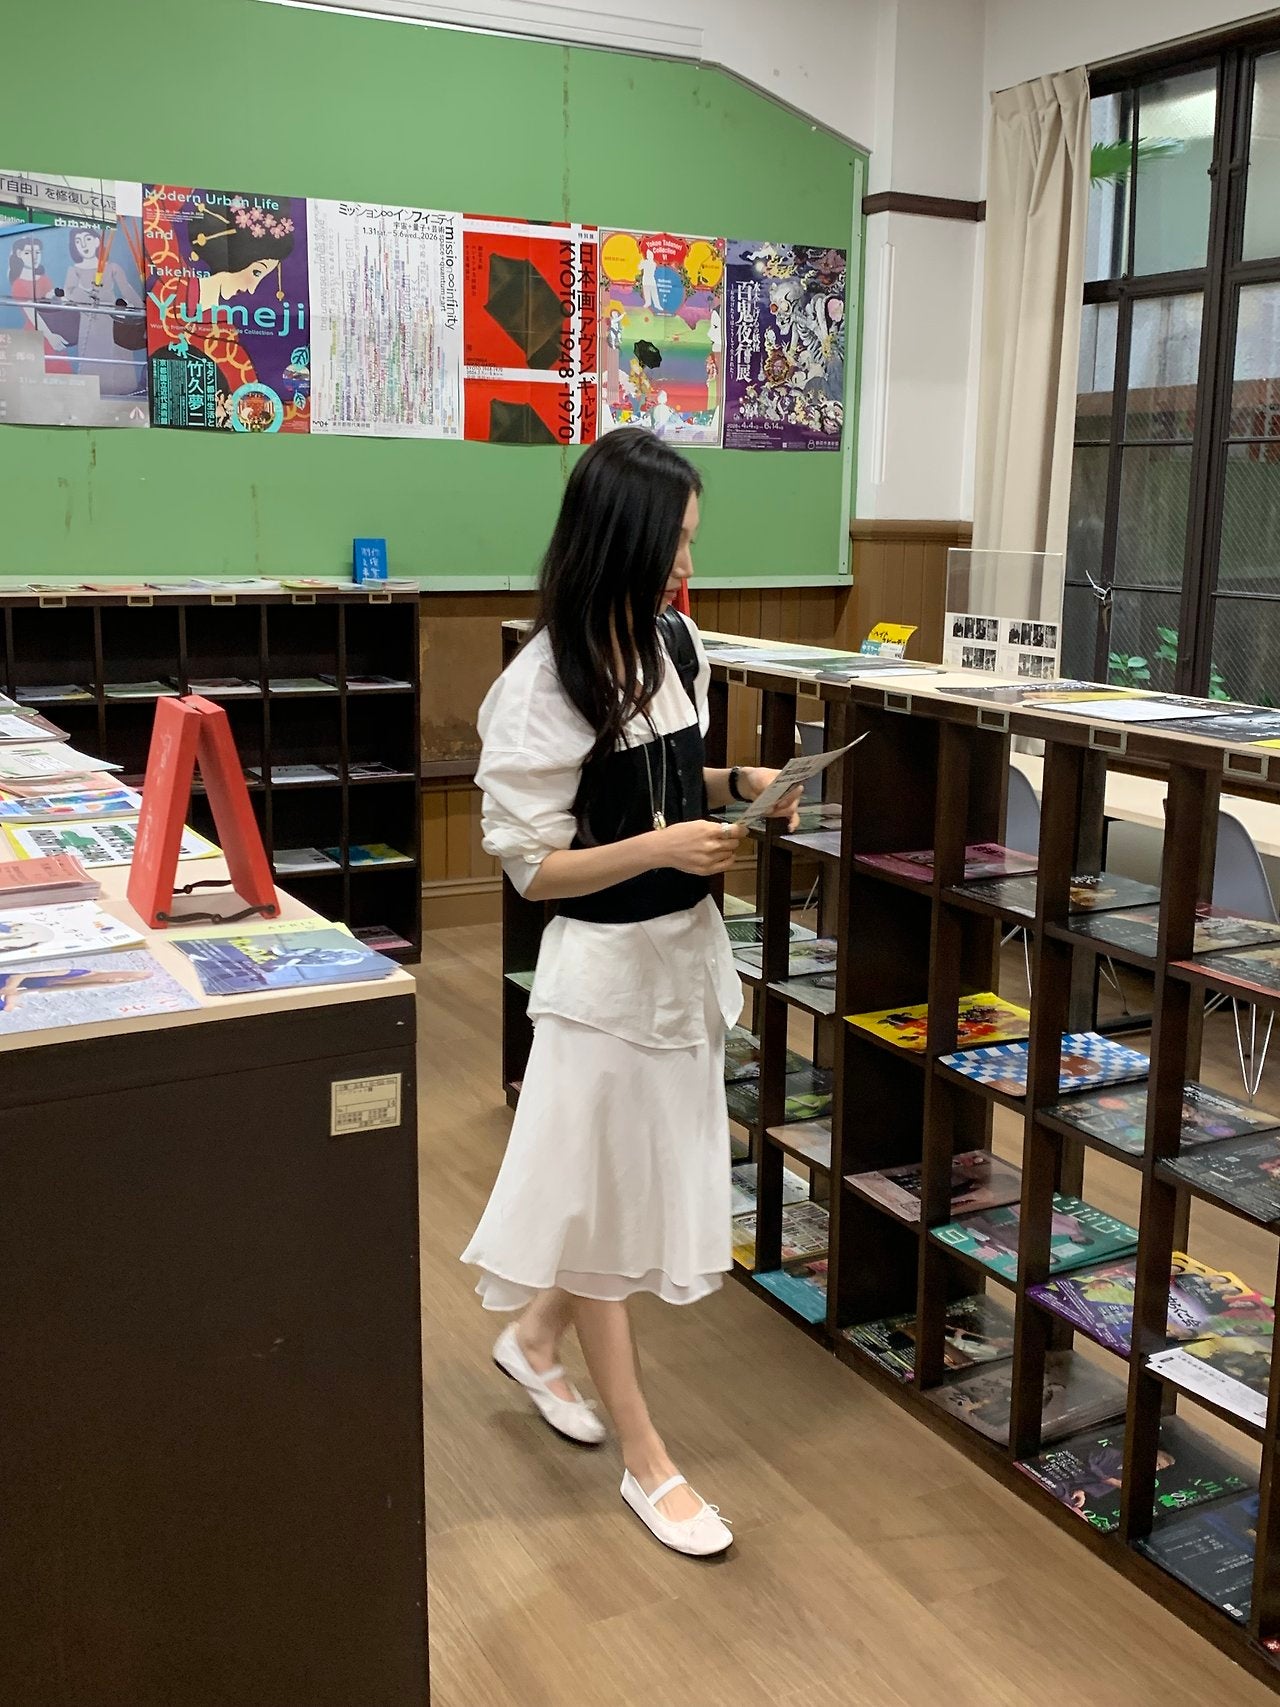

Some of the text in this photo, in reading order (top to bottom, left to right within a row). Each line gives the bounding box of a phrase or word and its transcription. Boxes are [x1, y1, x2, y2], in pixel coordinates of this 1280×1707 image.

[145, 188, 201, 204] Modern
[254, 198, 279, 211] Life
[145, 228, 174, 240] and
[148, 264, 211, 280] Takehisa
[147, 291, 305, 337] Yumeji
[558, 240, 576, 439] KYOTO 1948-1970
[577, 243, 596, 440] 日本画アヴァンギャルド
[735, 280, 755, 383] 百鬼夜行展
[187, 360, 205, 426] 竹久夢二
